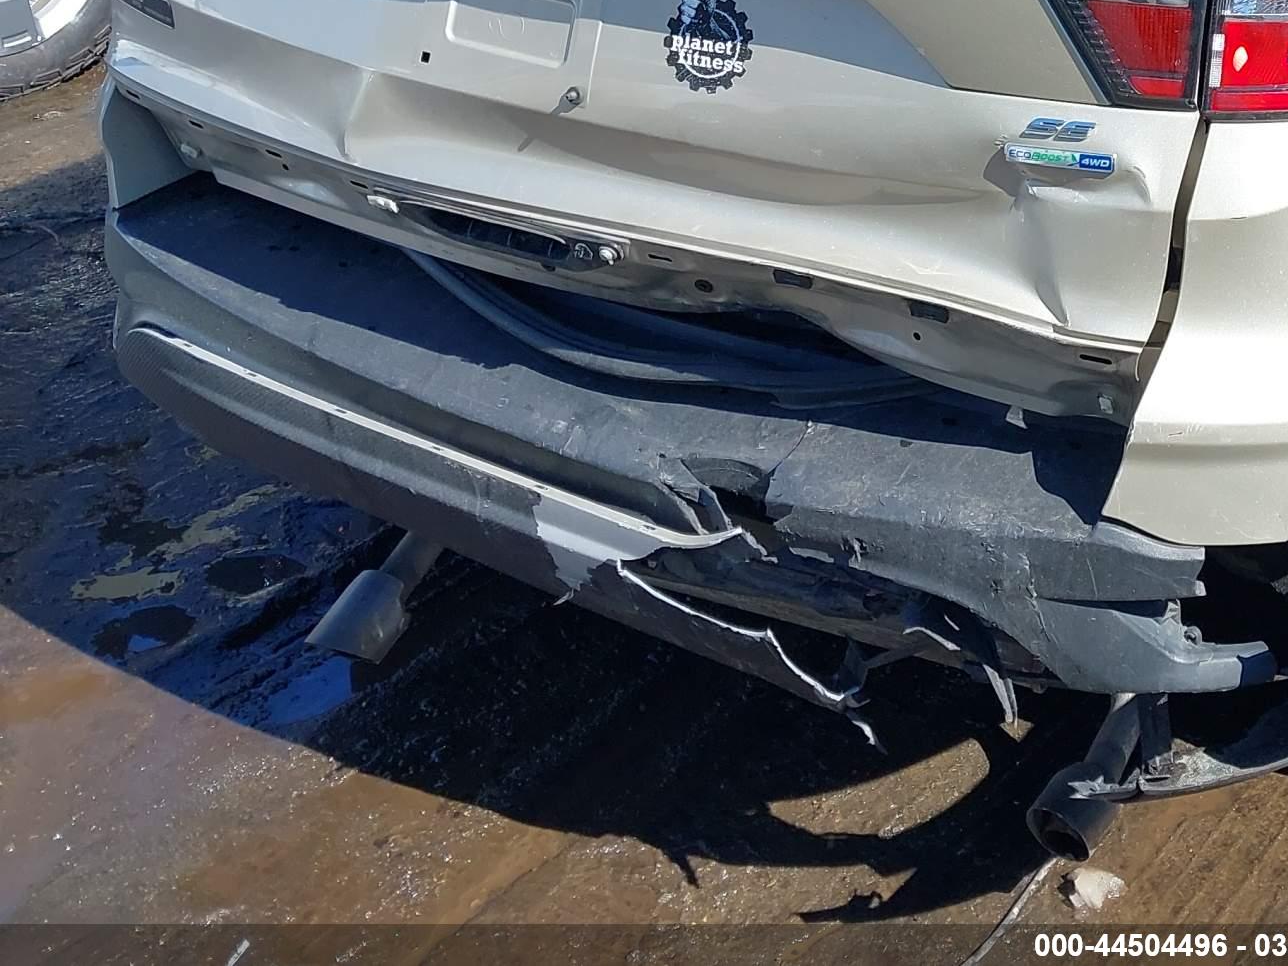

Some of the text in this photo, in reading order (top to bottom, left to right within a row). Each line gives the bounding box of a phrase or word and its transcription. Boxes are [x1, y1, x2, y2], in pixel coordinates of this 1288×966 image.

[671, 33, 733, 56] planet
[677, 48, 744, 74] fitness
[1019, 117, 1097, 143] SE
[1081, 157, 1110, 168] 4WD
